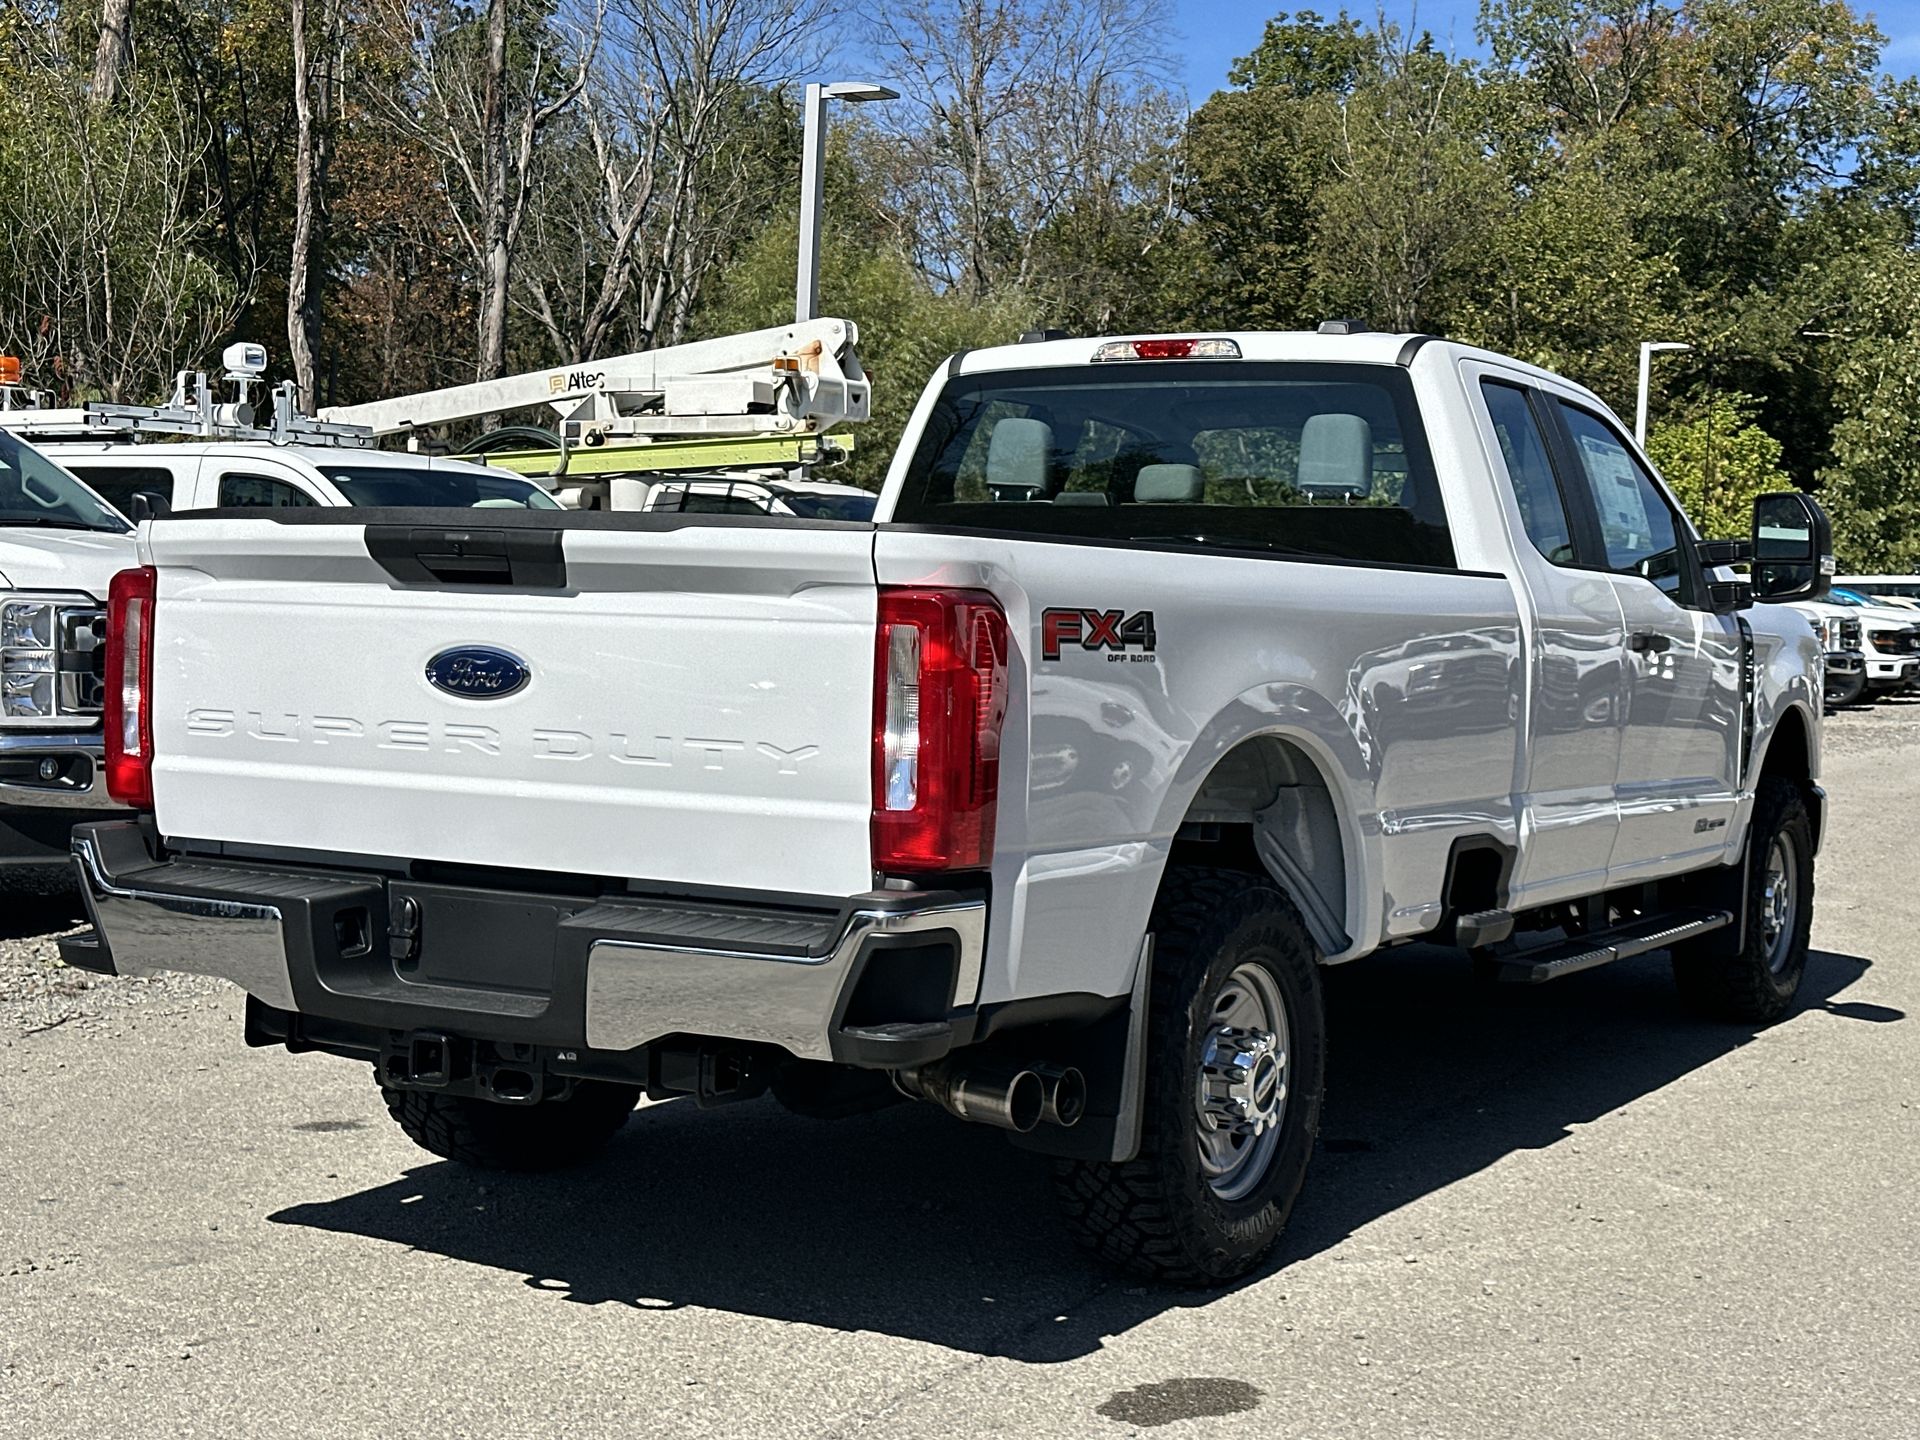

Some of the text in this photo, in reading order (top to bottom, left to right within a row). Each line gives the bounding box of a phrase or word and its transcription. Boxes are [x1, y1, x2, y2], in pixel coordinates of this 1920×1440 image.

[1041, 607, 1156, 661] FX4
[1107, 654, 1156, 663] OFF ROAD
[185, 708, 820, 775] SUPER DUTY
